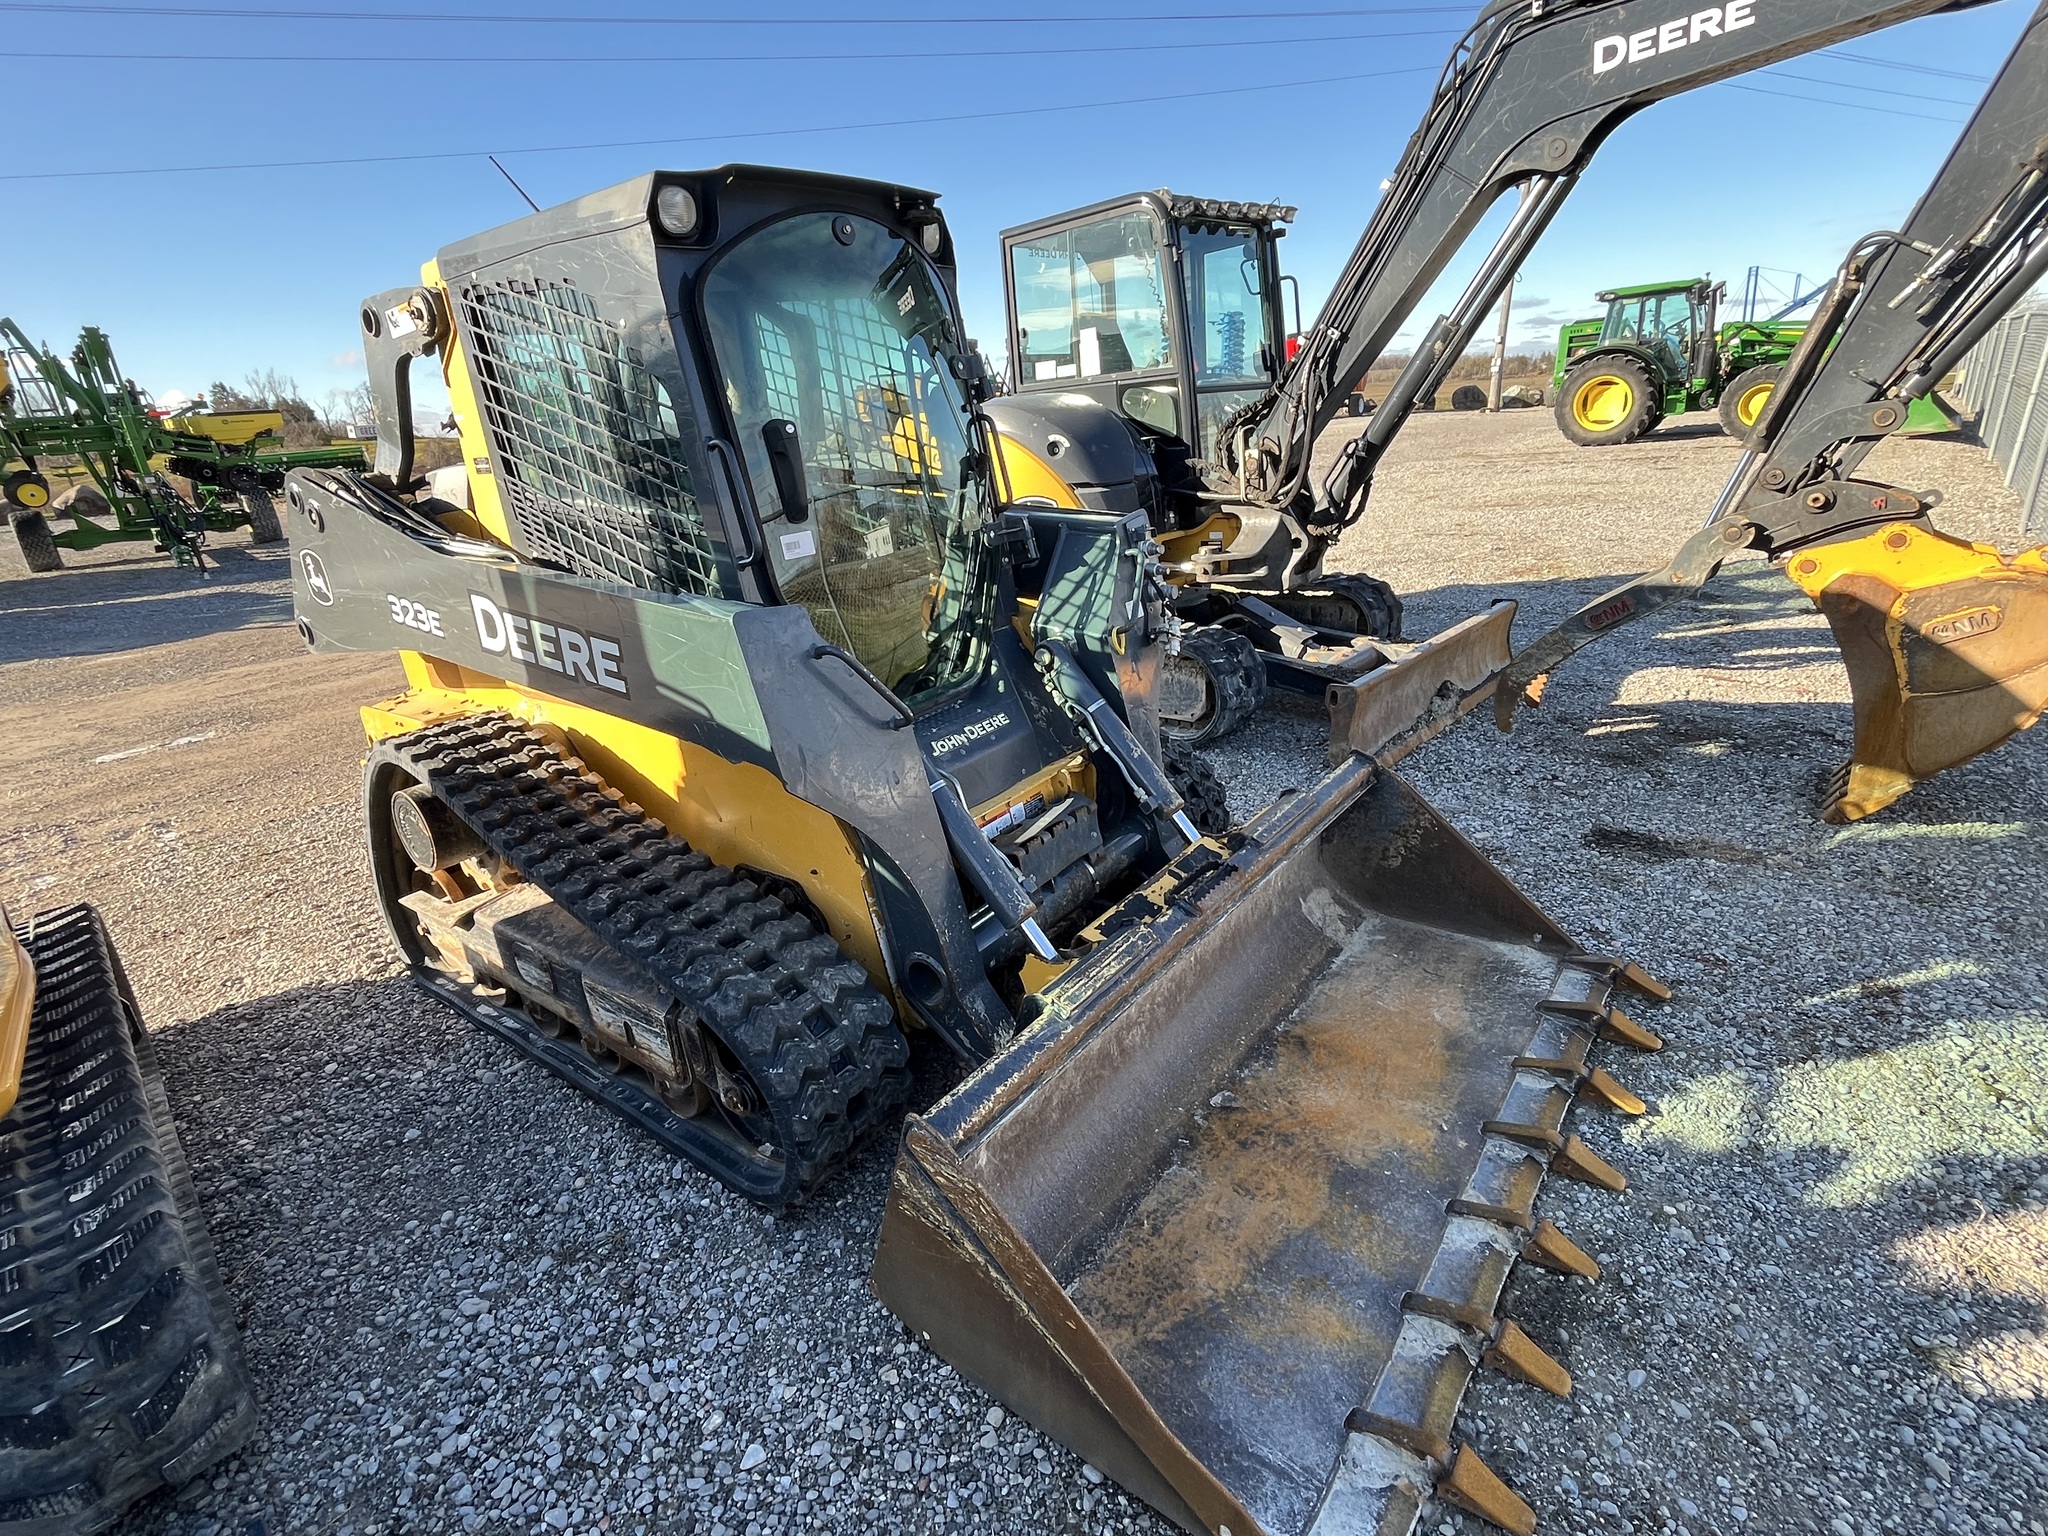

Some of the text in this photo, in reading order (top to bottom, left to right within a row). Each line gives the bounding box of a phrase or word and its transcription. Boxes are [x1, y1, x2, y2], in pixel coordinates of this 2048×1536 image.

[1593, 0, 1757, 75] DEERE
[360, 427, 377, 435] GREE
[386, 594, 445, 638] 323E
[470, 593, 627, 693] DEERE
[931, 713, 1010, 757] JOHN DEERE
